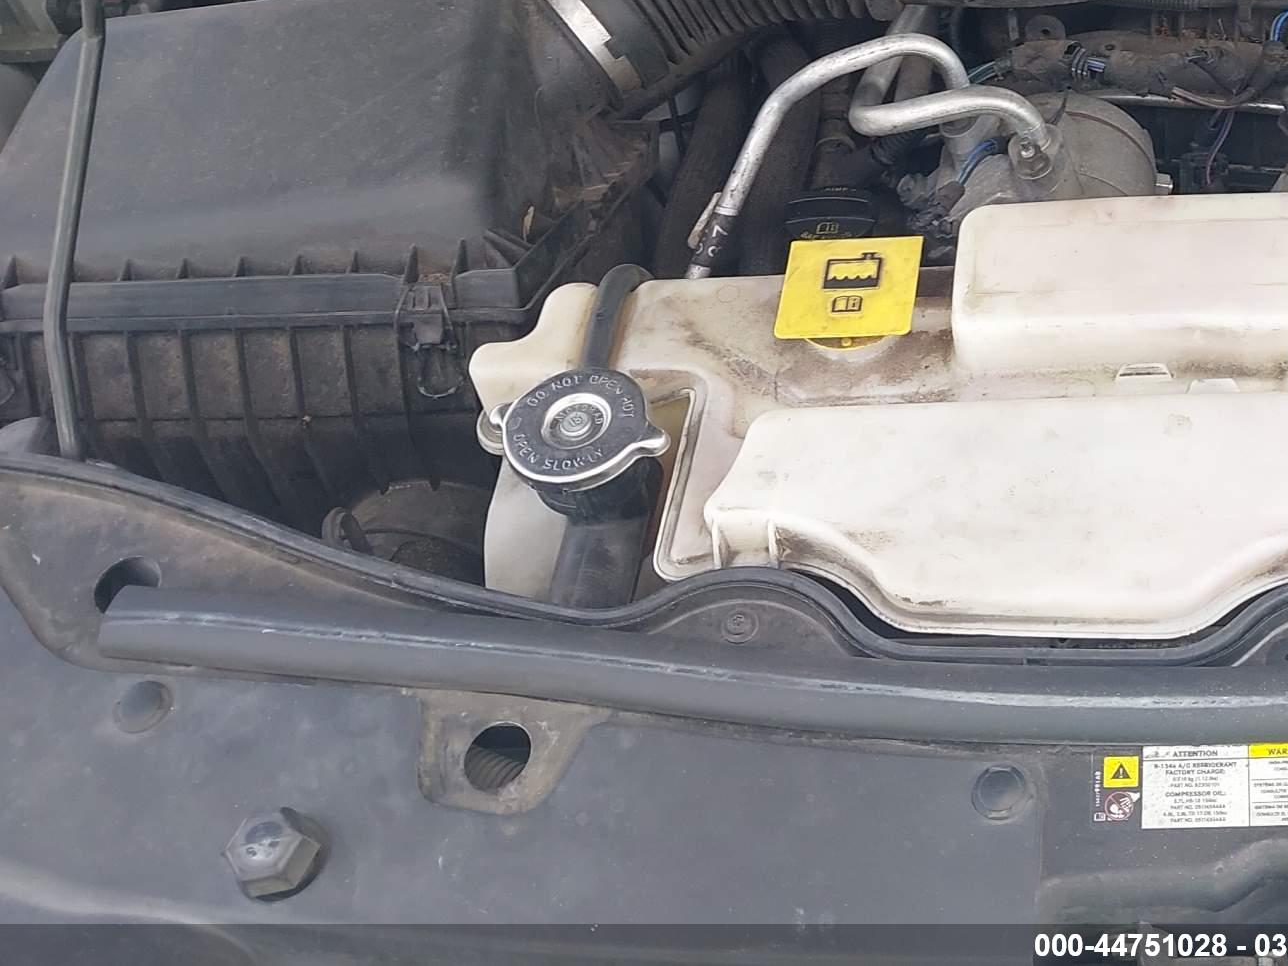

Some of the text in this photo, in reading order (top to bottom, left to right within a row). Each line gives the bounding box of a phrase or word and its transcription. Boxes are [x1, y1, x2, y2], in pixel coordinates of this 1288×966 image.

[527, 390, 547, 408] DO
[550, 374, 583, 391] NOT
[513, 433, 606, 472] OPEN SLOWLY
[1172, 750, 1218, 758] ATTENTION
